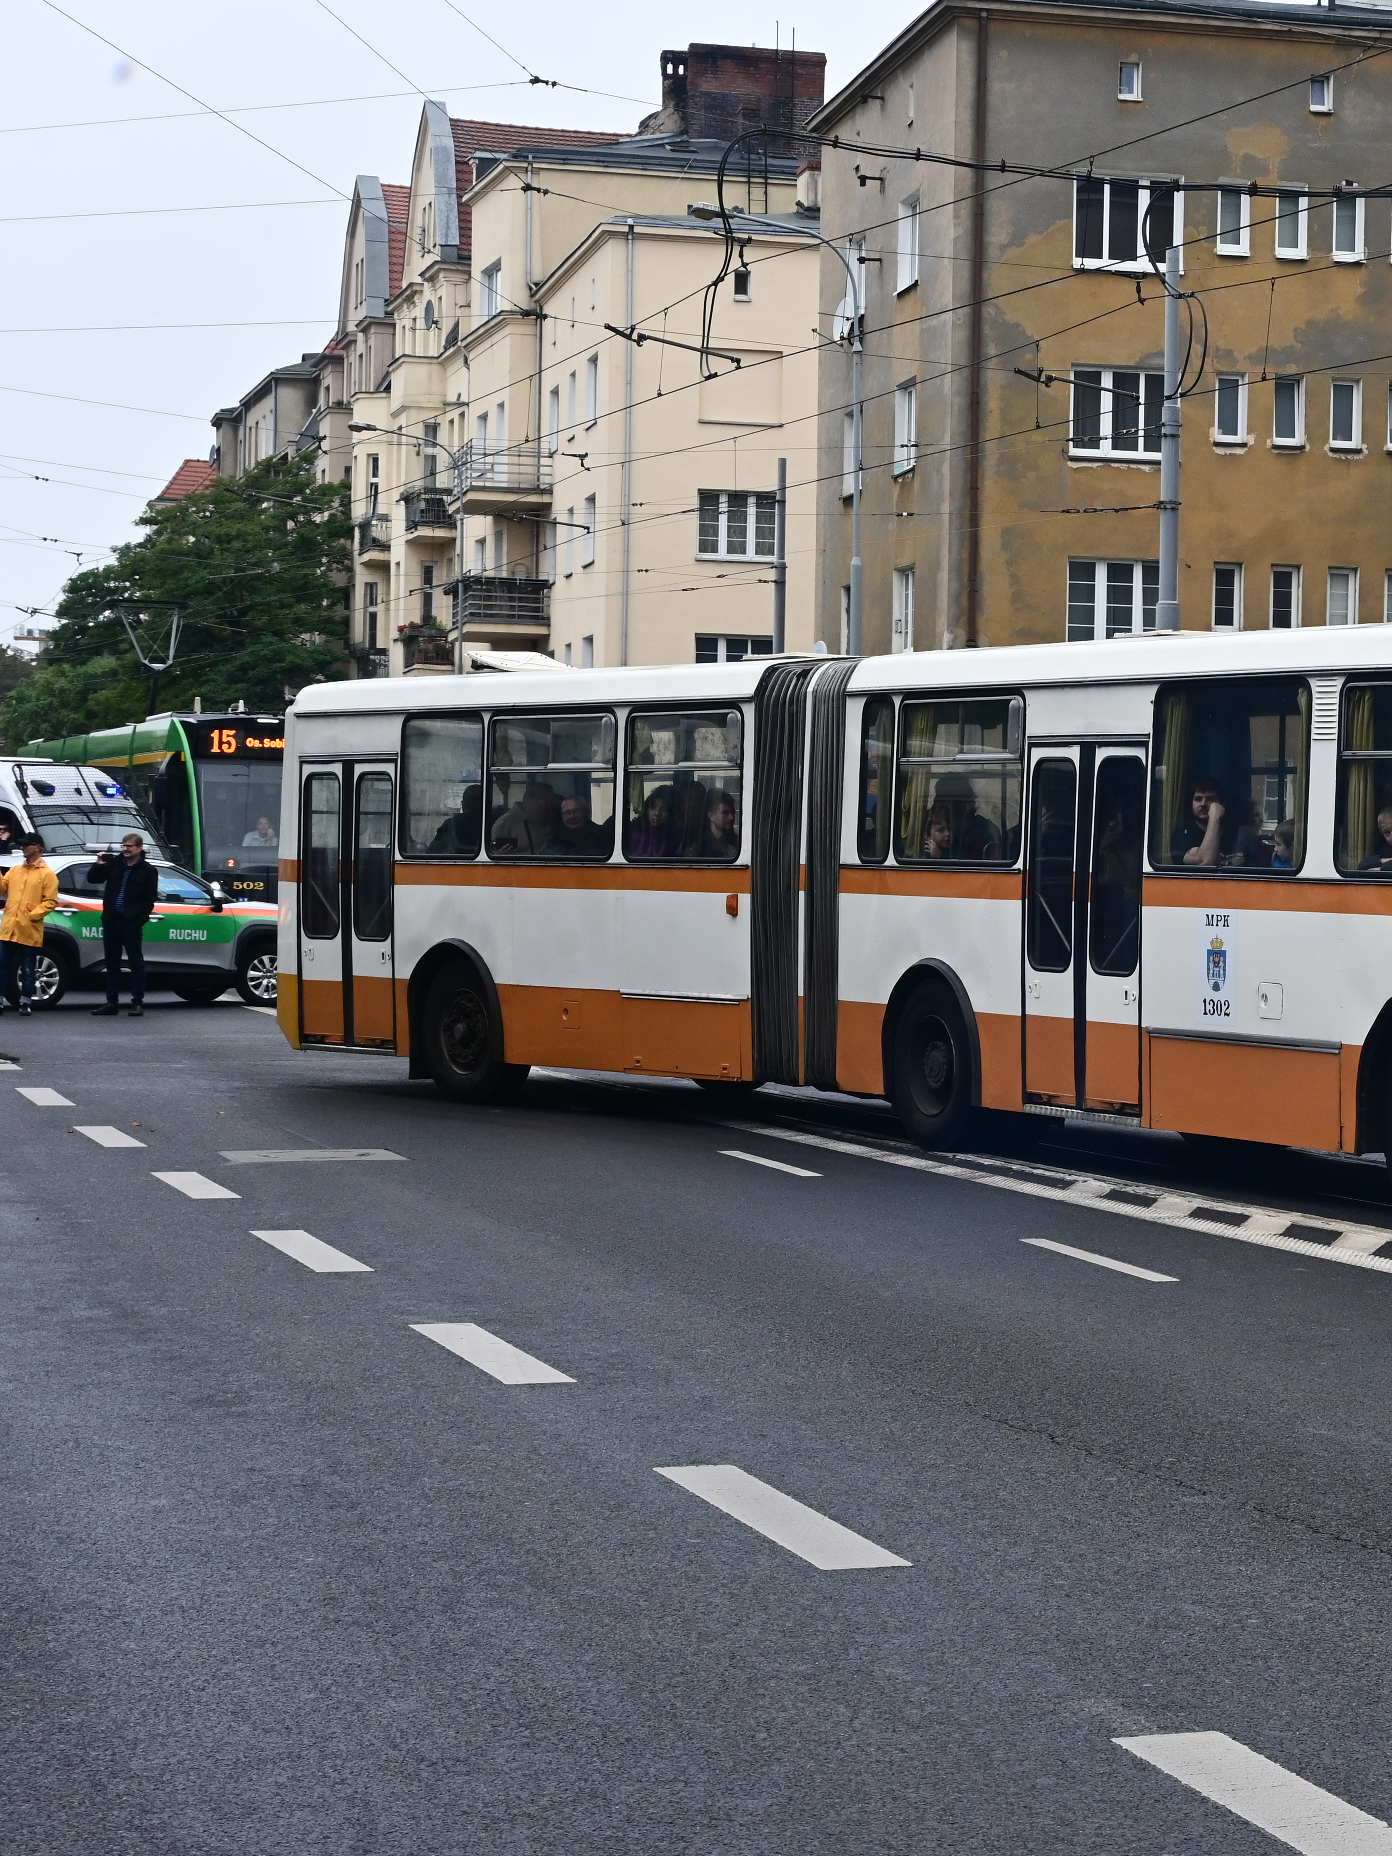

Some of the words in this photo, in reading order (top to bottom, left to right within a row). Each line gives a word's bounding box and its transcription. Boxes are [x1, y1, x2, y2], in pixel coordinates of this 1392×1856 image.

[210, 729, 237, 754] 15
[246, 738, 263, 748] Os.
[227, 859, 236, 867] 2
[232, 881, 264, 891] 502
[1205, 914, 1230, 928] MPK
[169, 928, 207, 941] RUCHU
[1202, 998, 1231, 1017] 1302
